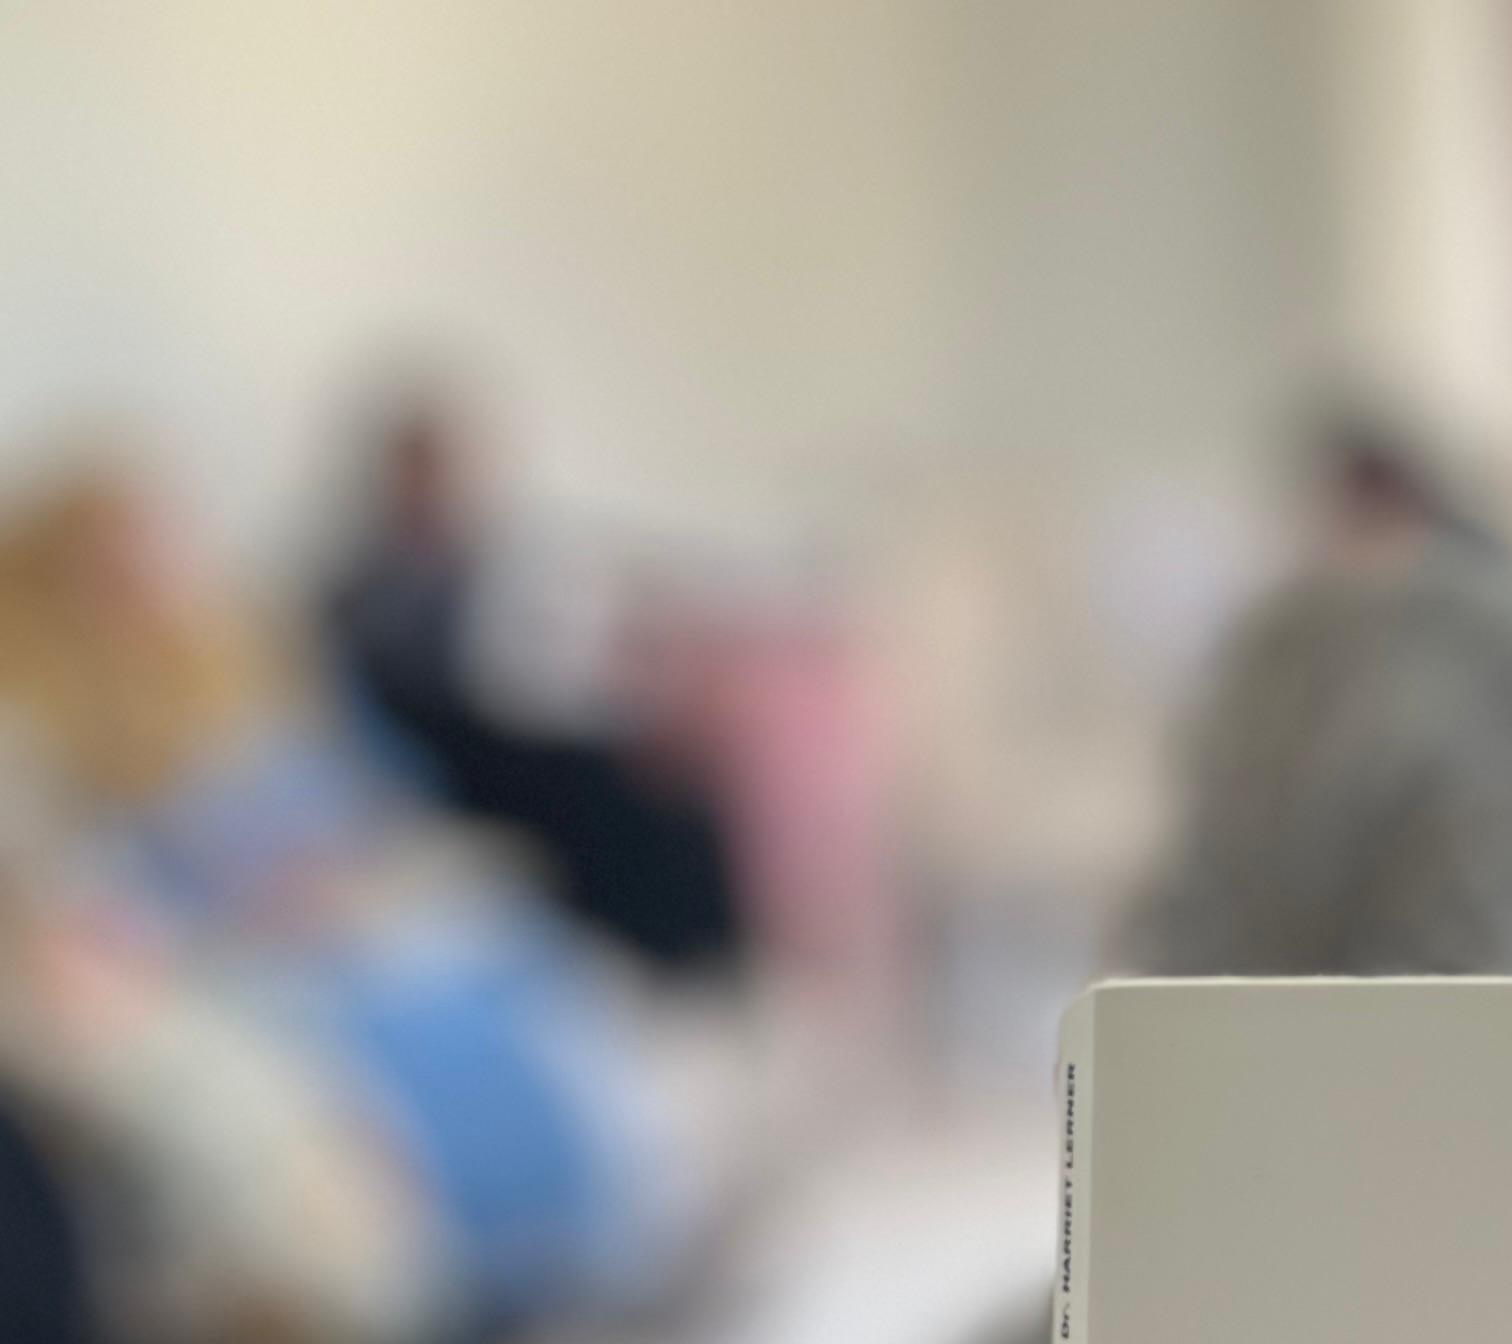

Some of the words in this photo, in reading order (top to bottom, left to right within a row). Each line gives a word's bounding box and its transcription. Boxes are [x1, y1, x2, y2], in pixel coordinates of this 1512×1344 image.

[1065, 1062, 1076, 1169] LERNER
[1062, 1176, 1074, 1294] HARRIET
[1060, 1302, 1070, 1341] Dr.
